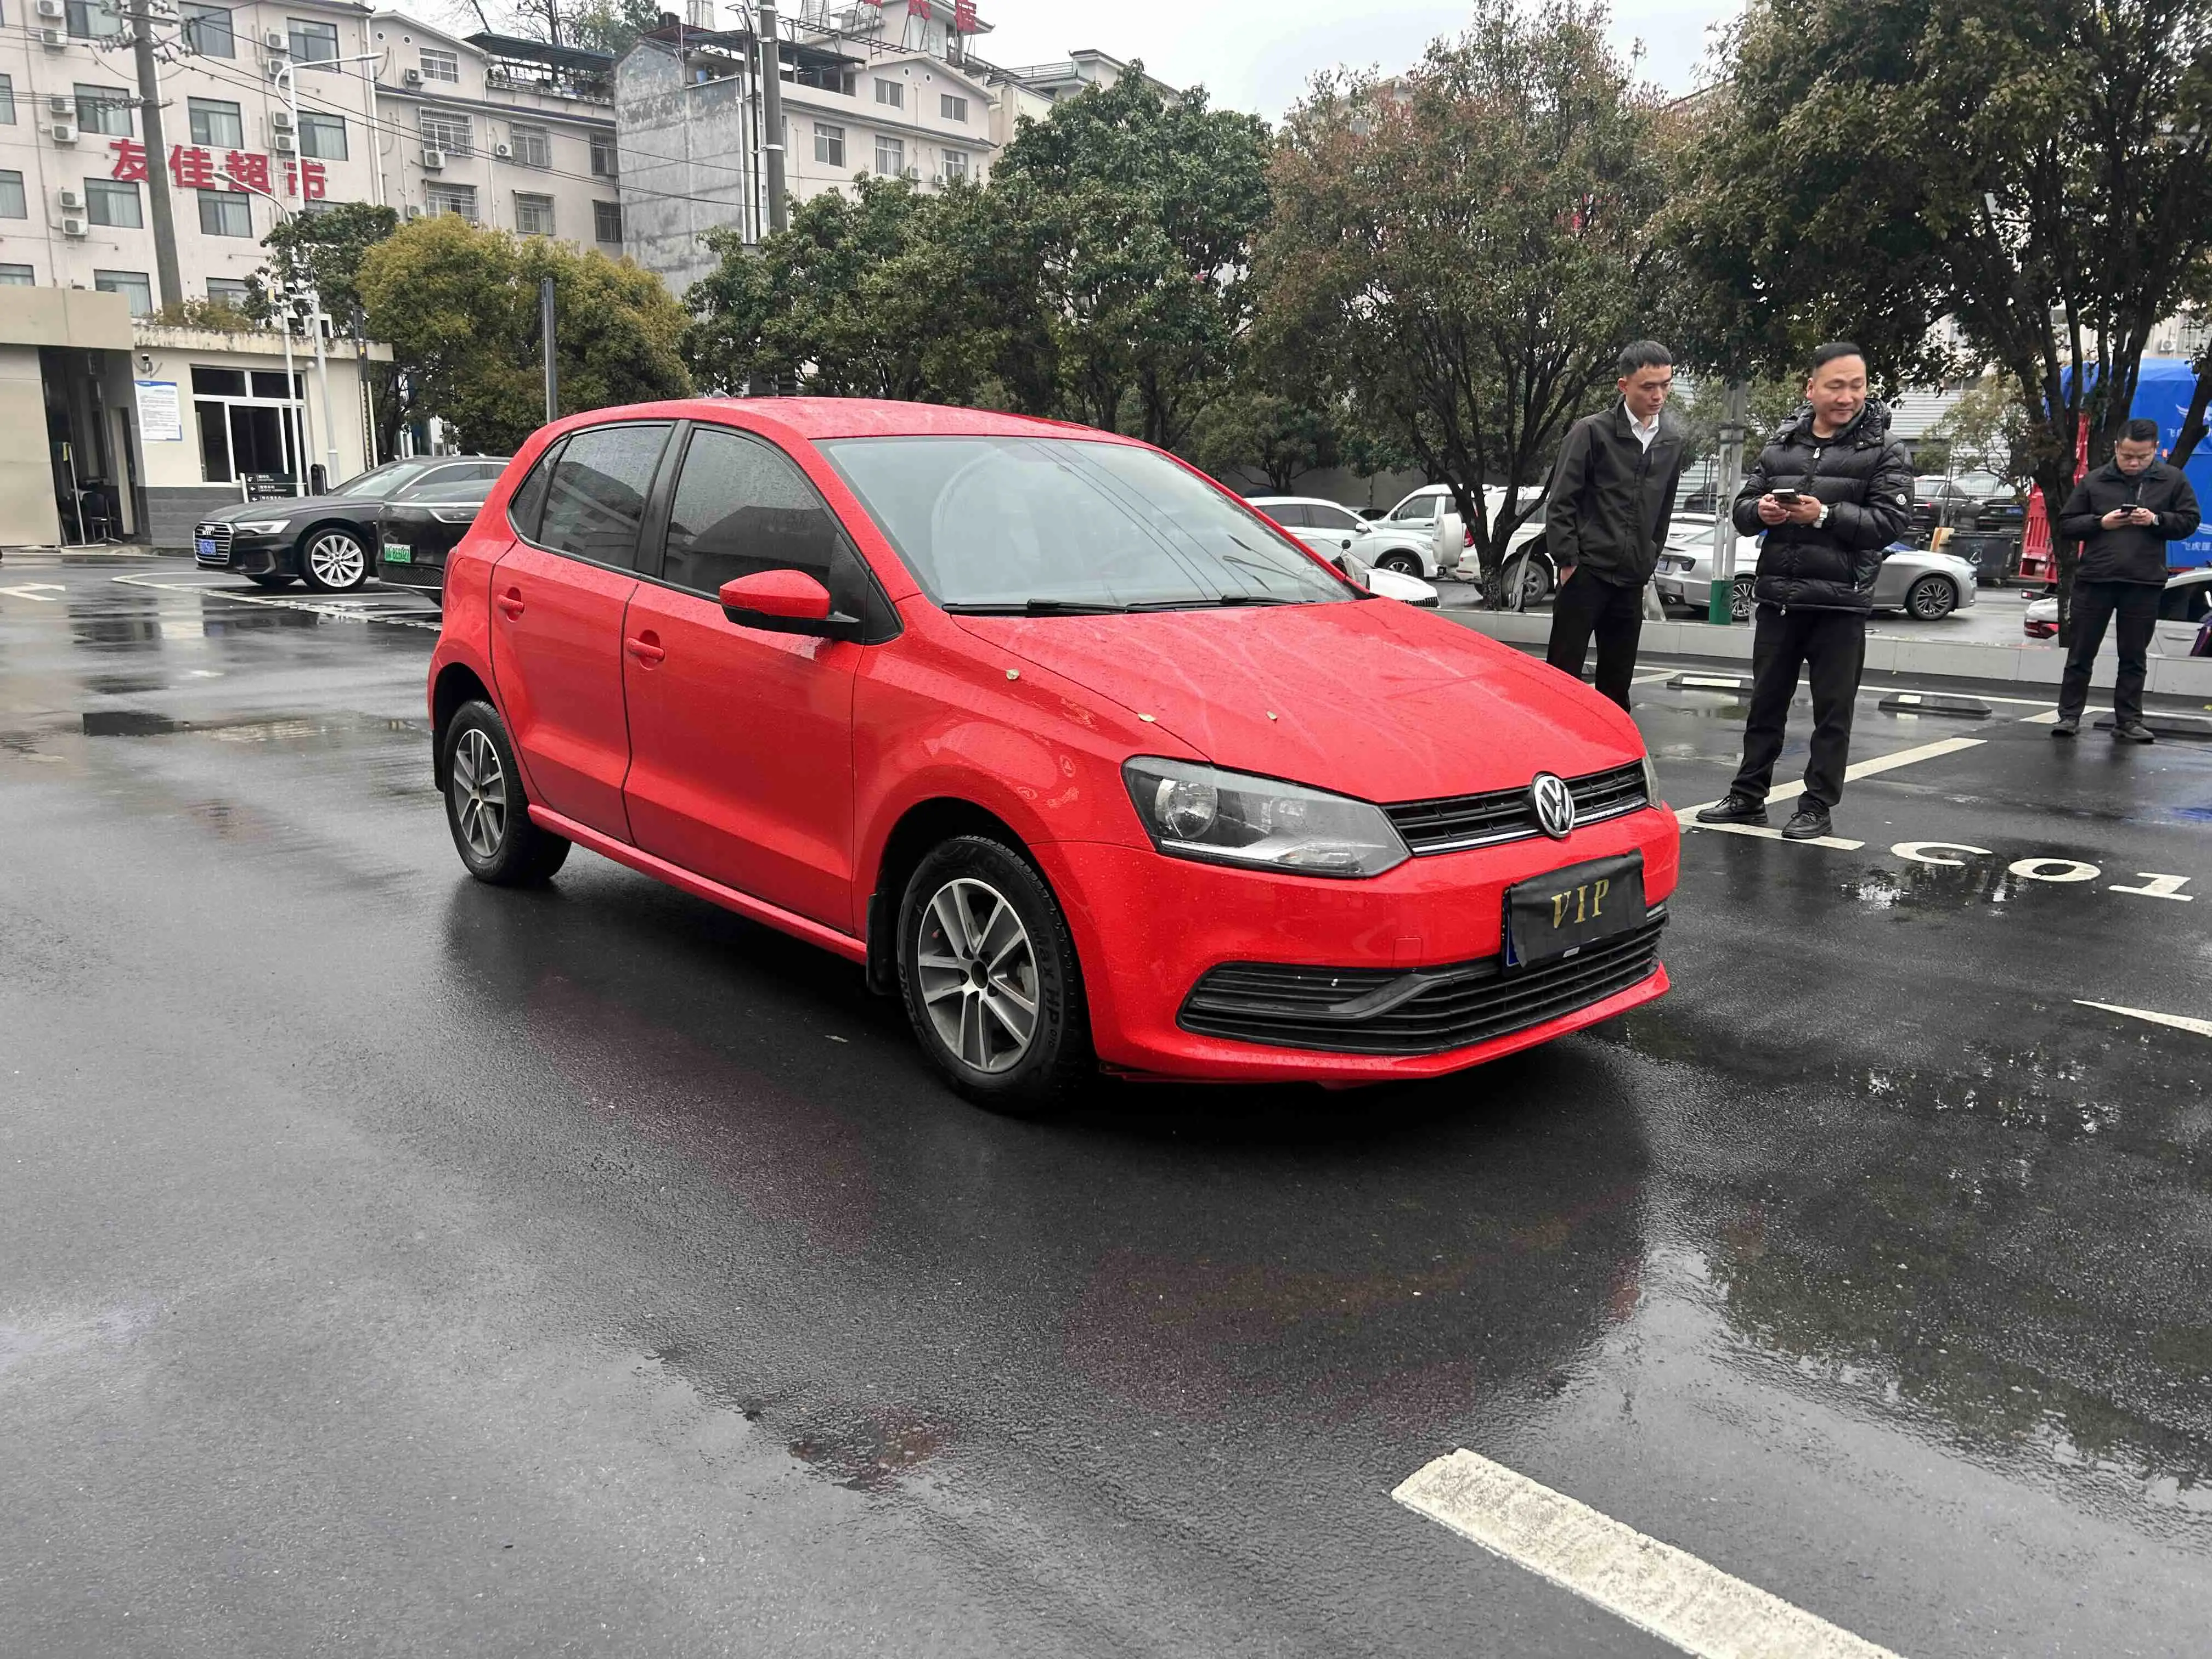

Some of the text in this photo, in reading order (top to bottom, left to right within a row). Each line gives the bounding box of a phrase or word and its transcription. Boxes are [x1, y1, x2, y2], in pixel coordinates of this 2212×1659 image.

[109, 138, 326, 201] 友佳超市
[1551, 879, 1610, 929] VIP
